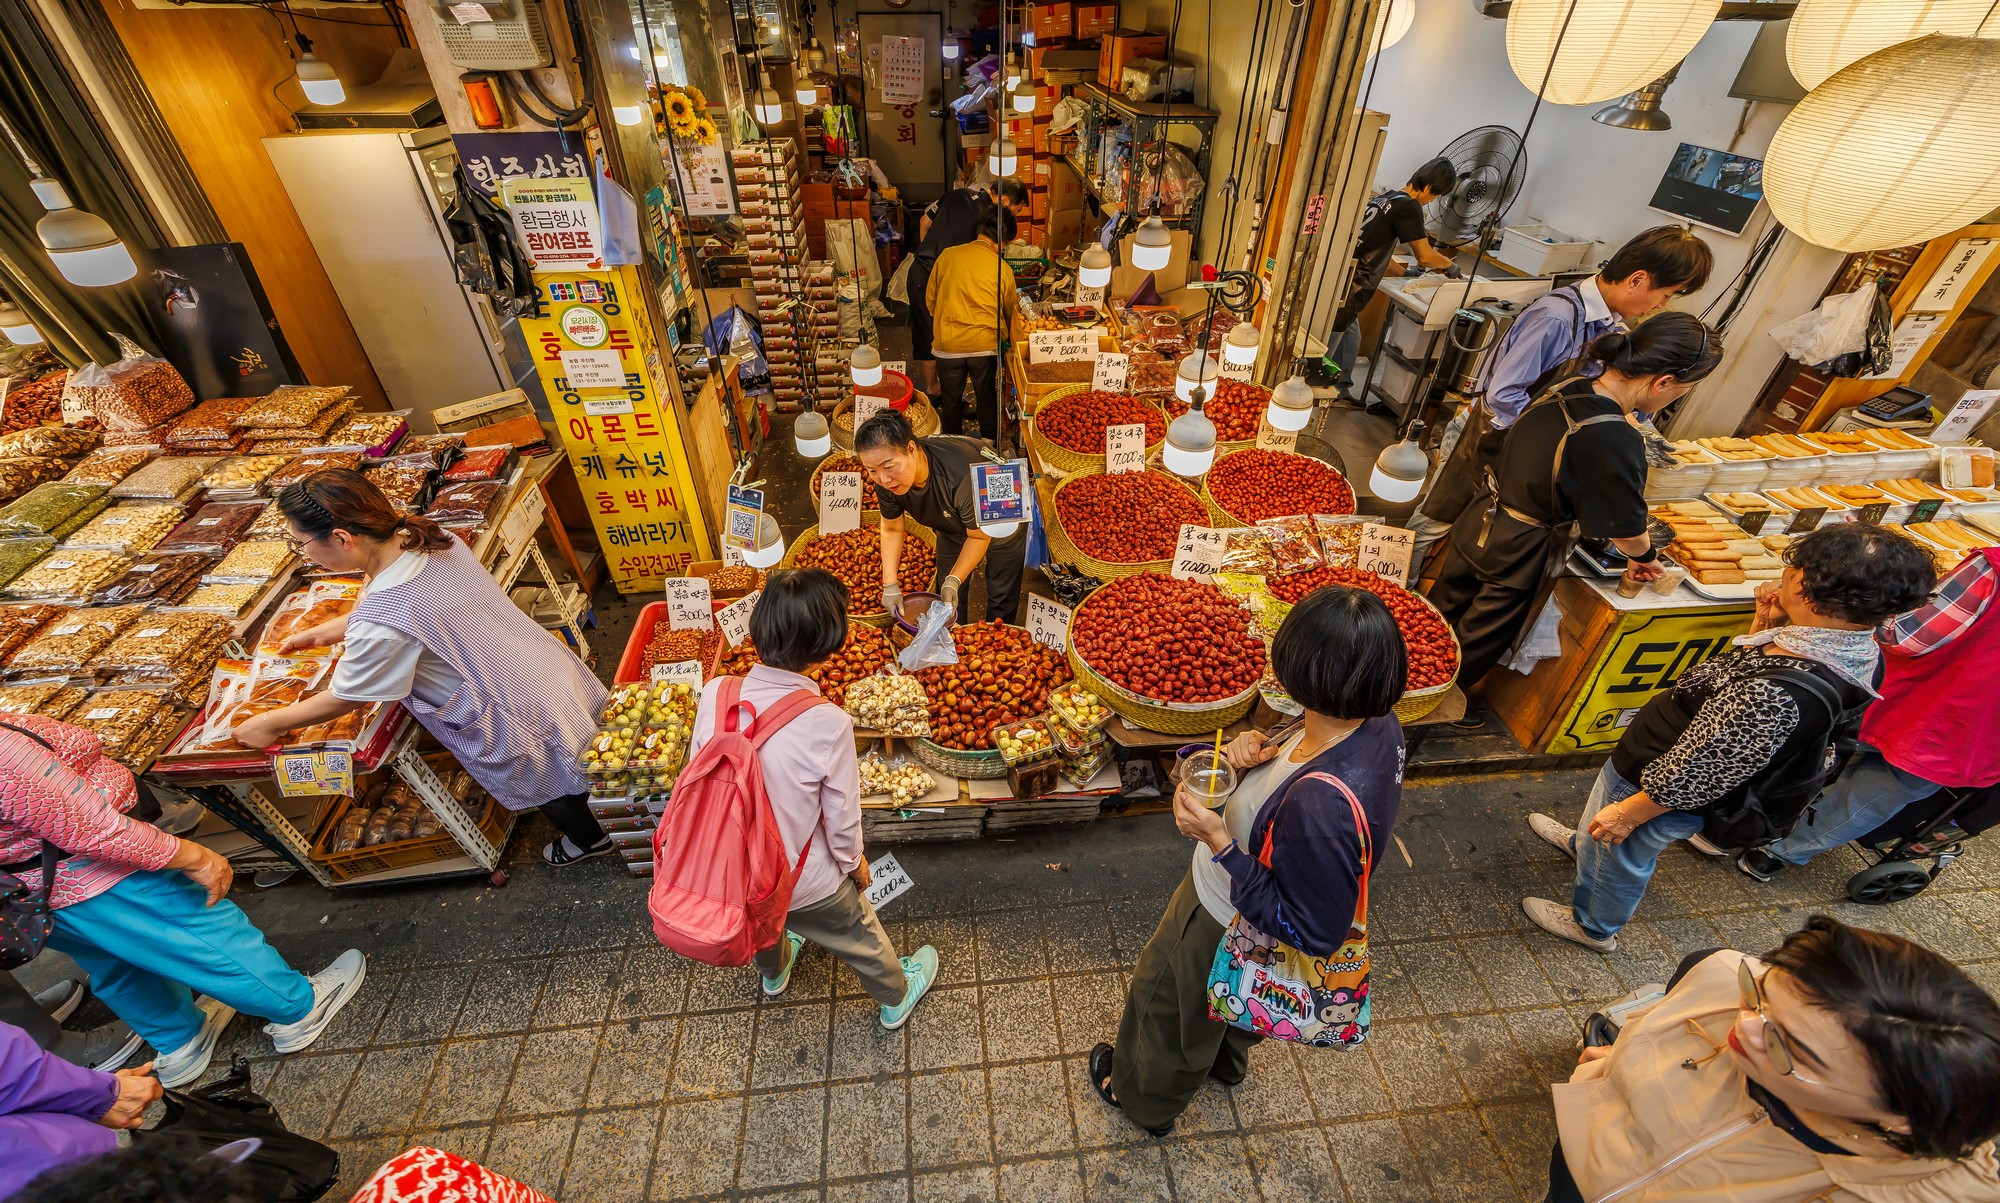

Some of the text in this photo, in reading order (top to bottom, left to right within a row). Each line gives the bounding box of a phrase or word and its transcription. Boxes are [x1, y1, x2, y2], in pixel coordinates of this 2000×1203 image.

[513, 193, 577, 204] 전통시장 환급행사
[518, 210, 587, 230] 환급행사
[526, 231, 593, 251] 참여점포
[569, 325, 596, 335] 빠른배송
[570, 316, 598, 326] 우리시장
[569, 413, 660, 445] 아몬드
[580, 451, 669, 480] 케슈넛
[595, 486, 679, 514] 호박씨
[606, 521, 688, 548] 해바라기
[618, 552, 695, 579] 수입견과류
[690, 589, 710, 601] 땅콩
[1250, 978, 1312, 1021] HAWAII
